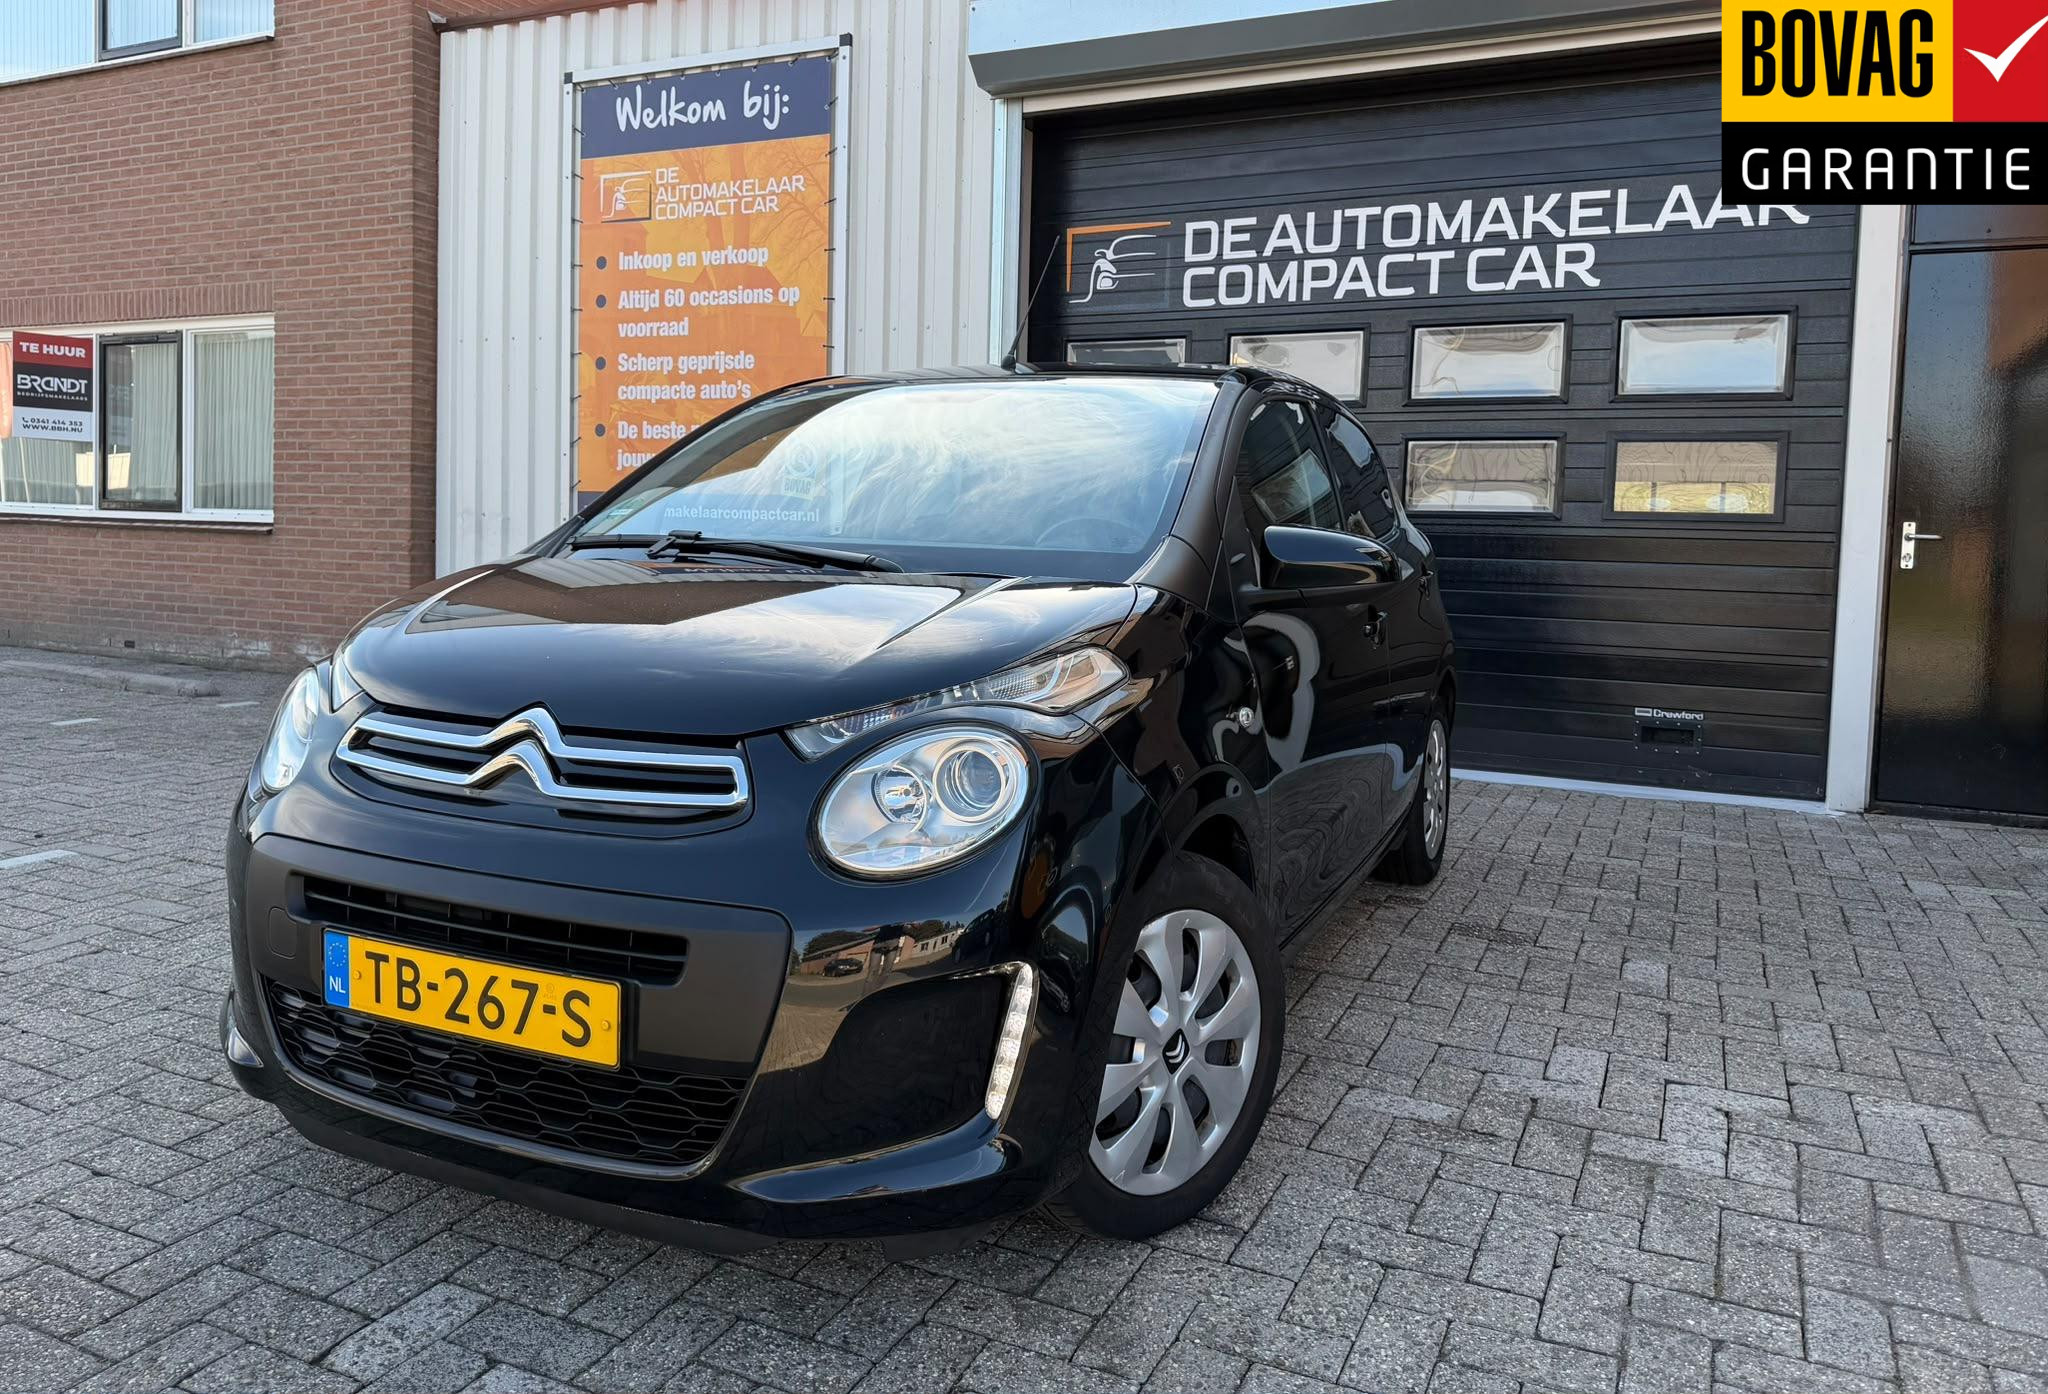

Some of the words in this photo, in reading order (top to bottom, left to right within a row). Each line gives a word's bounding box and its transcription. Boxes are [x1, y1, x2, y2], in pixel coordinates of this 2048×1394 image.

[615, 85, 727, 132] Welkom
[743, 80, 790, 130] bij:
[655, 167, 680, 184] DE
[655, 175, 806, 203] AUTOMAKELAAR
[655, 199, 738, 221] COMPACT
[740, 196, 780, 214] CAR
[1184, 216, 1258, 263] DE
[618, 251, 672, 272] Inkoop
[677, 250, 697, 267] en
[702, 245, 769, 267] verkoop
[1183, 250, 1456, 308] COMPACT
[1466, 242, 1601, 293] CAR
[617, 289, 660, 313] Altijd
[664, 287, 684, 307] 60
[689, 285, 774, 307] occasions
[778, 285, 800, 307] op
[617, 317, 689, 337] voorraad
[19, 342, 40, 354] TE
[42, 344, 86, 358] HUUR
[617, 352, 674, 375] Scherp
[678, 351, 755, 374] geprijsde
[617, 383, 696, 404] compacte
[700, 380, 751, 400] auto's
[617, 421, 638, 439] De
[642, 420, 687, 439] beste
[663, 506, 820, 523] makelaarcompactcar.nl
[329, 976, 346, 994] NL
[365, 950, 592, 1047] TB-267-S
